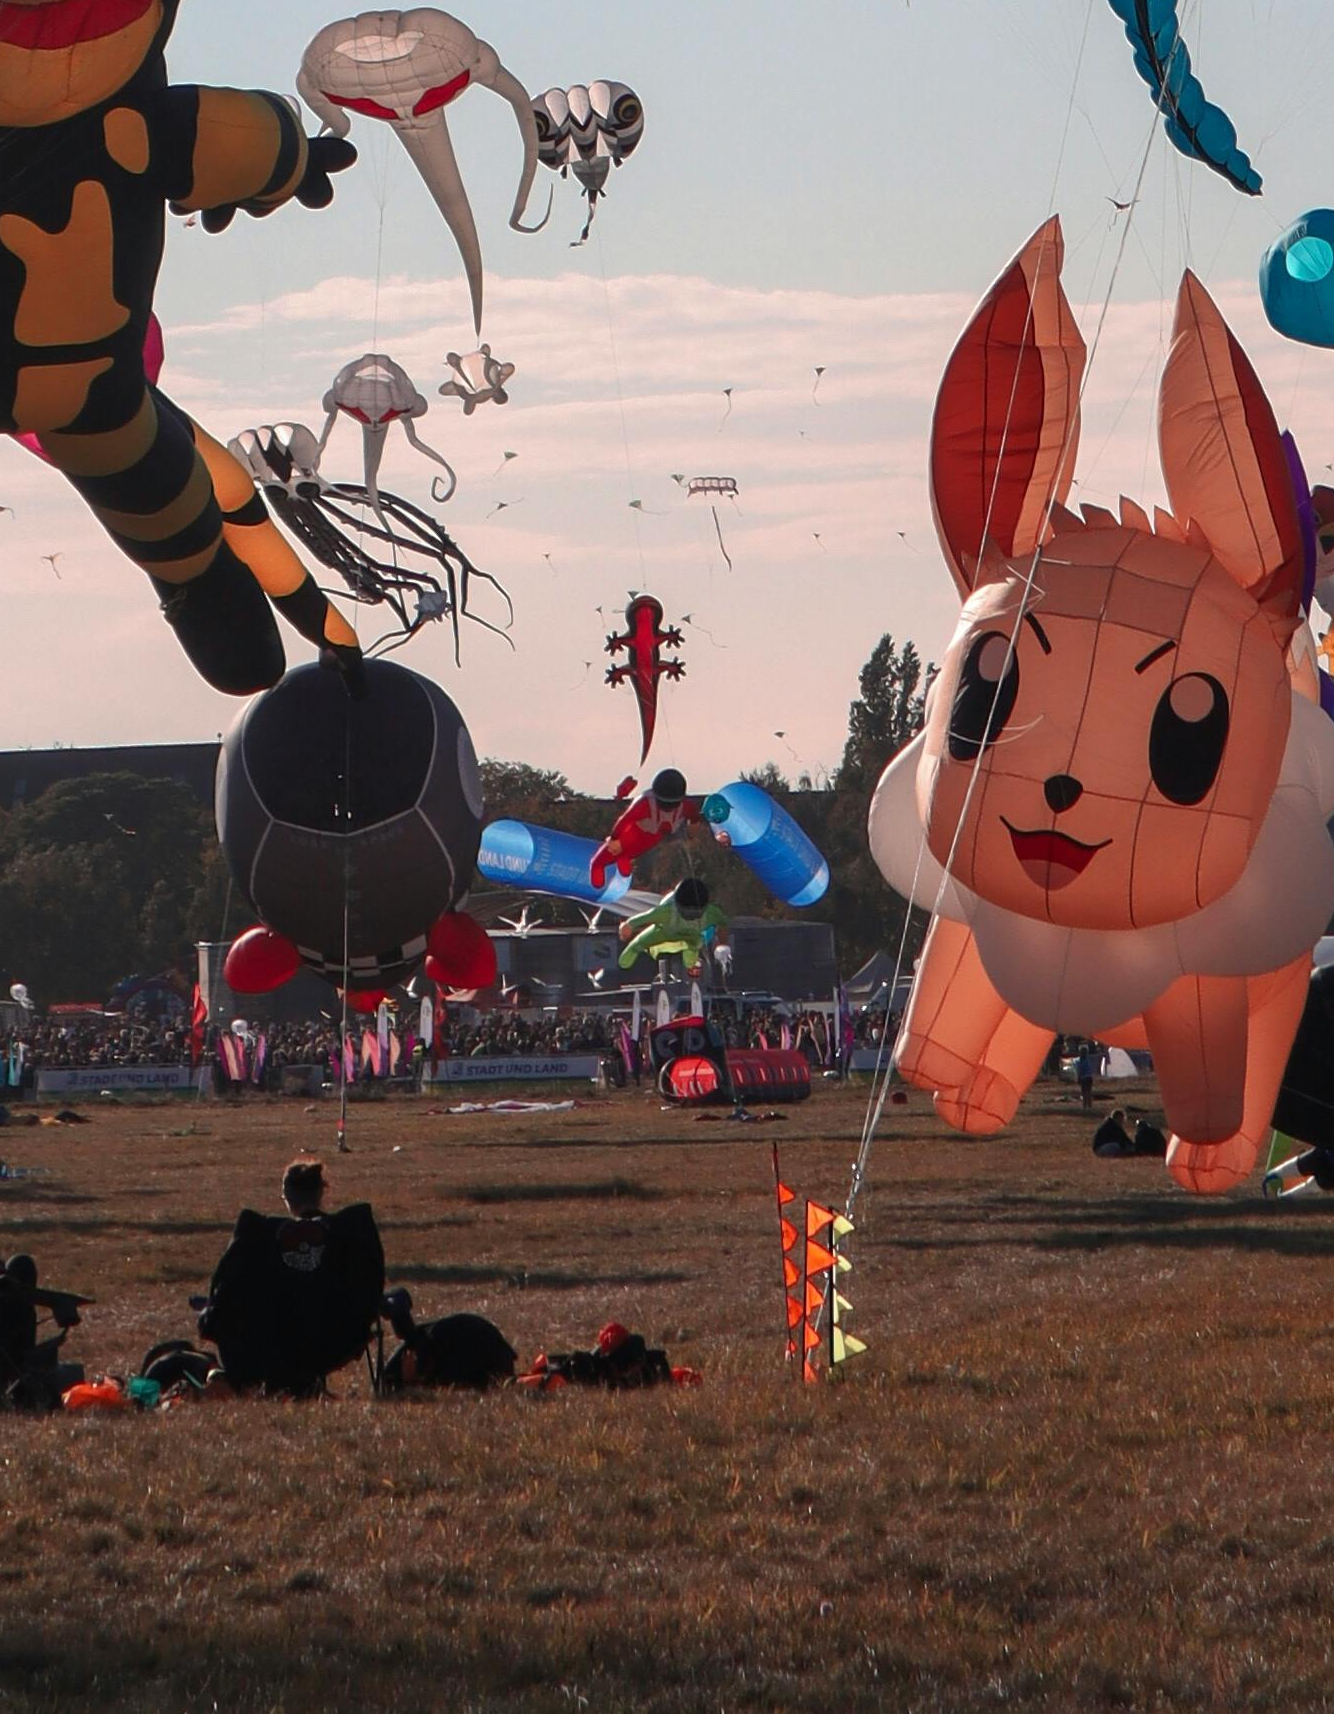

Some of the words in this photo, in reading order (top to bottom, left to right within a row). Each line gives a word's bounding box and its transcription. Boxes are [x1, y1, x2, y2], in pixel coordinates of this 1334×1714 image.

[466, 1065, 503, 1076] STADT
[505, 1064, 532, 1074] UND
[535, 1063, 569, 1073] LAND
[146, 1073, 179, 1084] LAND
